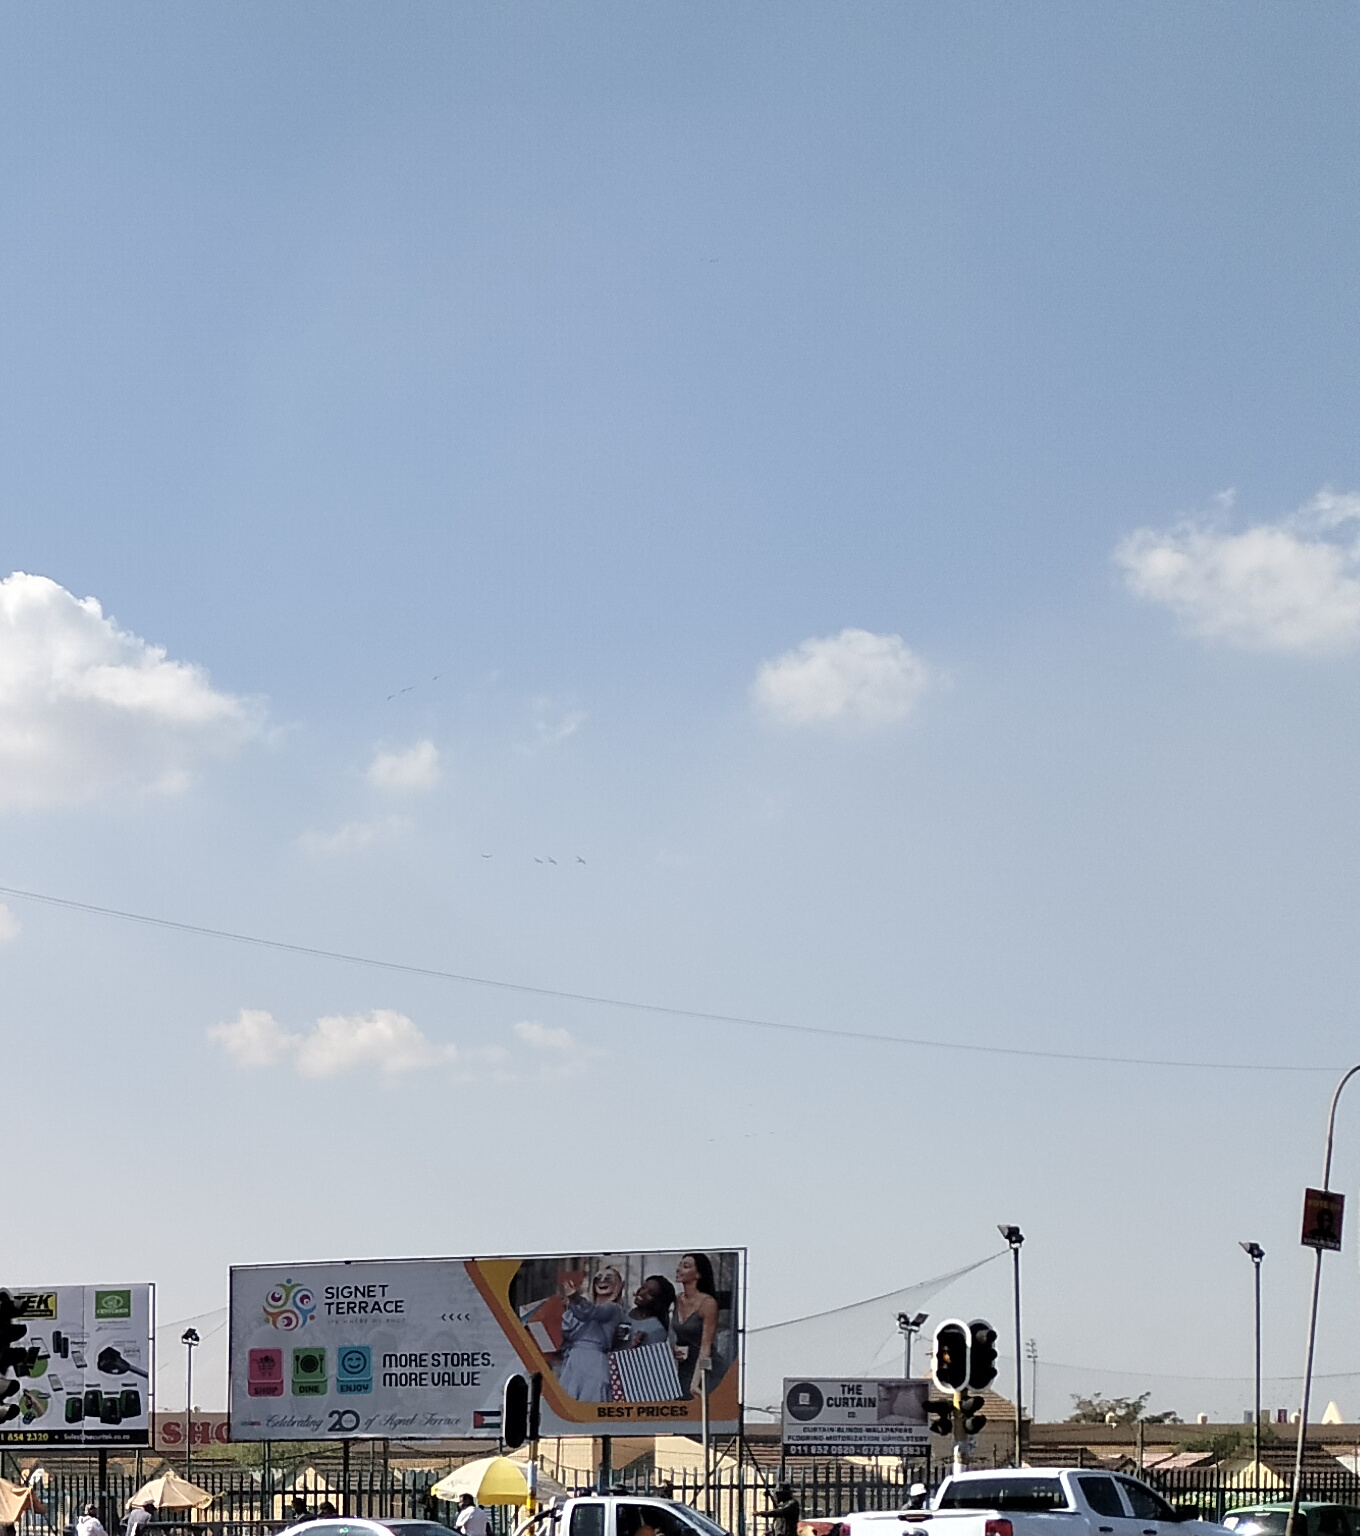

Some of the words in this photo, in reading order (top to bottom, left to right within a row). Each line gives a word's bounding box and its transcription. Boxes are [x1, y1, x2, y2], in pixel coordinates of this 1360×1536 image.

[324, 1284, 389, 1300] SIGNET
[324, 1300, 405, 1316] TERRACE
[382, 1353, 429, 1368] MORE
[430, 1352, 496, 1367] STORES.
[382, 1372, 429, 1387] MORE
[430, 1371, 481, 1386] VALUE
[254, 1386, 278, 1395] SHOP
[298, 1385, 320, 1394] DINE
[340, 1383, 369, 1393] ENJOY
[840, 1384, 863, 1396] THE
[826, 1396, 877, 1408] CURTAIN
[597, 1406, 634, 1418] BEST
[636, 1405, 689, 1417] PRICES
[265, 1413, 325, 1431] Celebrating
[327, 1409, 360, 1432] 20
[364, 1414, 380, 1431] of
[379, 1412, 418, 1431] Signet
[421, 1412, 461, 1426] Terrace
[26, 1432, 49, 1442] 2320
